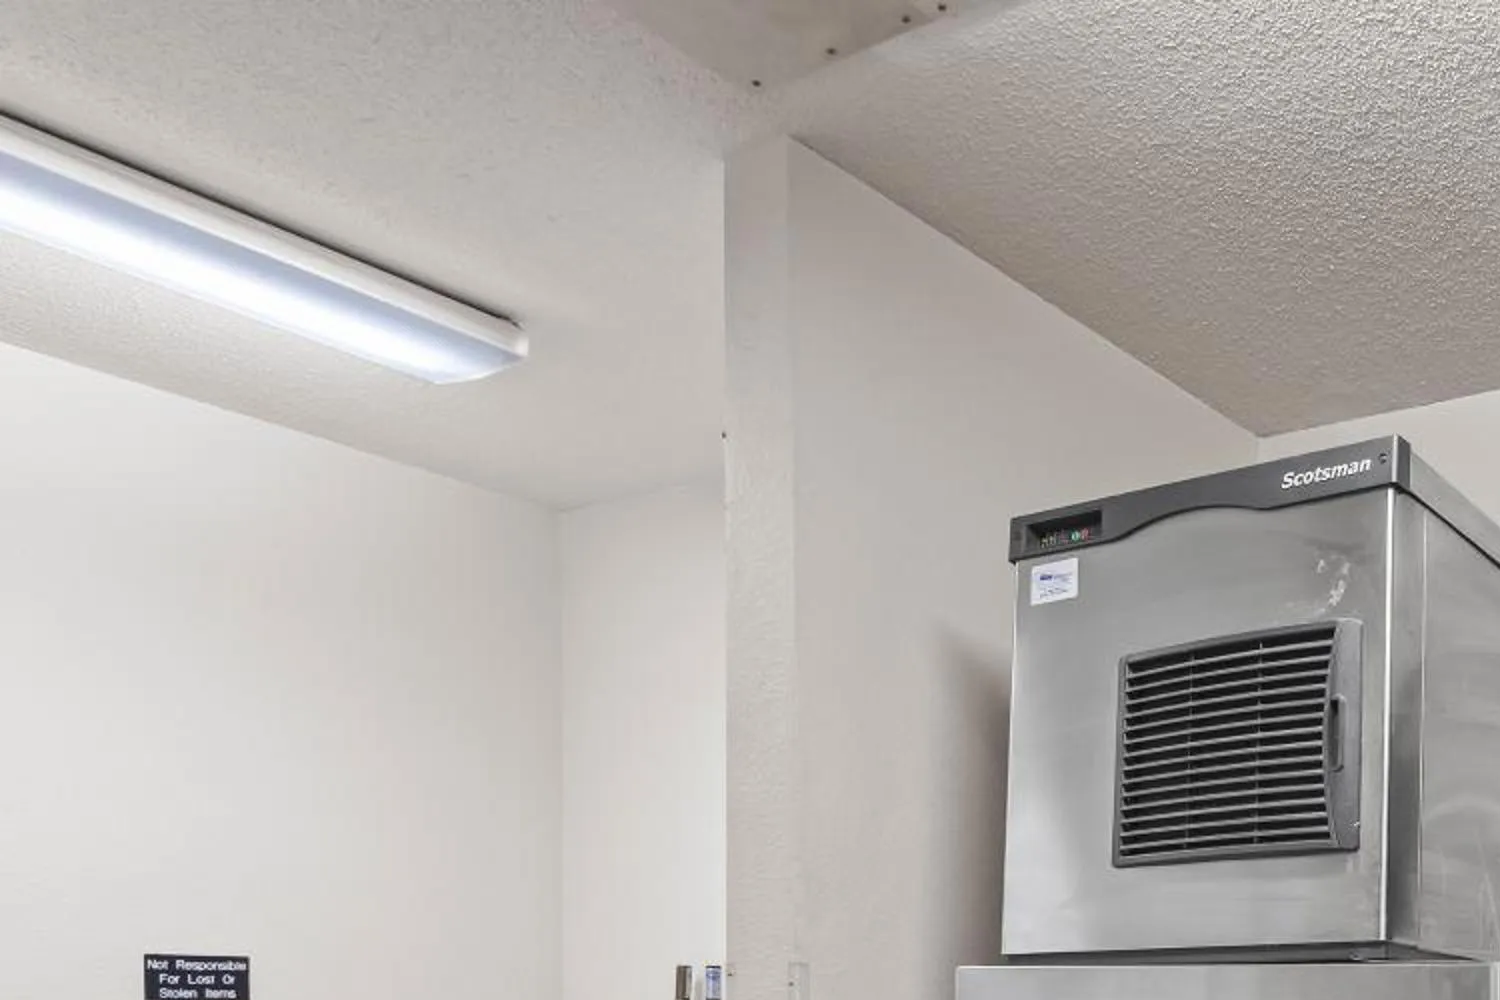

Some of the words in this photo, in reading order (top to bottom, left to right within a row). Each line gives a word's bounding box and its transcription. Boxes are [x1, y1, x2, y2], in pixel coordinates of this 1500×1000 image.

[1281, 459, 1371, 489] Scotsman
[147, 959, 169, 970] Not
[175, 959, 247, 971] Responsible
[159, 973, 181, 985] For
[187, 973, 215, 985] Lost
[222, 973, 236, 985] Or
[159, 987, 198, 999] Stolen
[205, 988, 237, 999] Items
